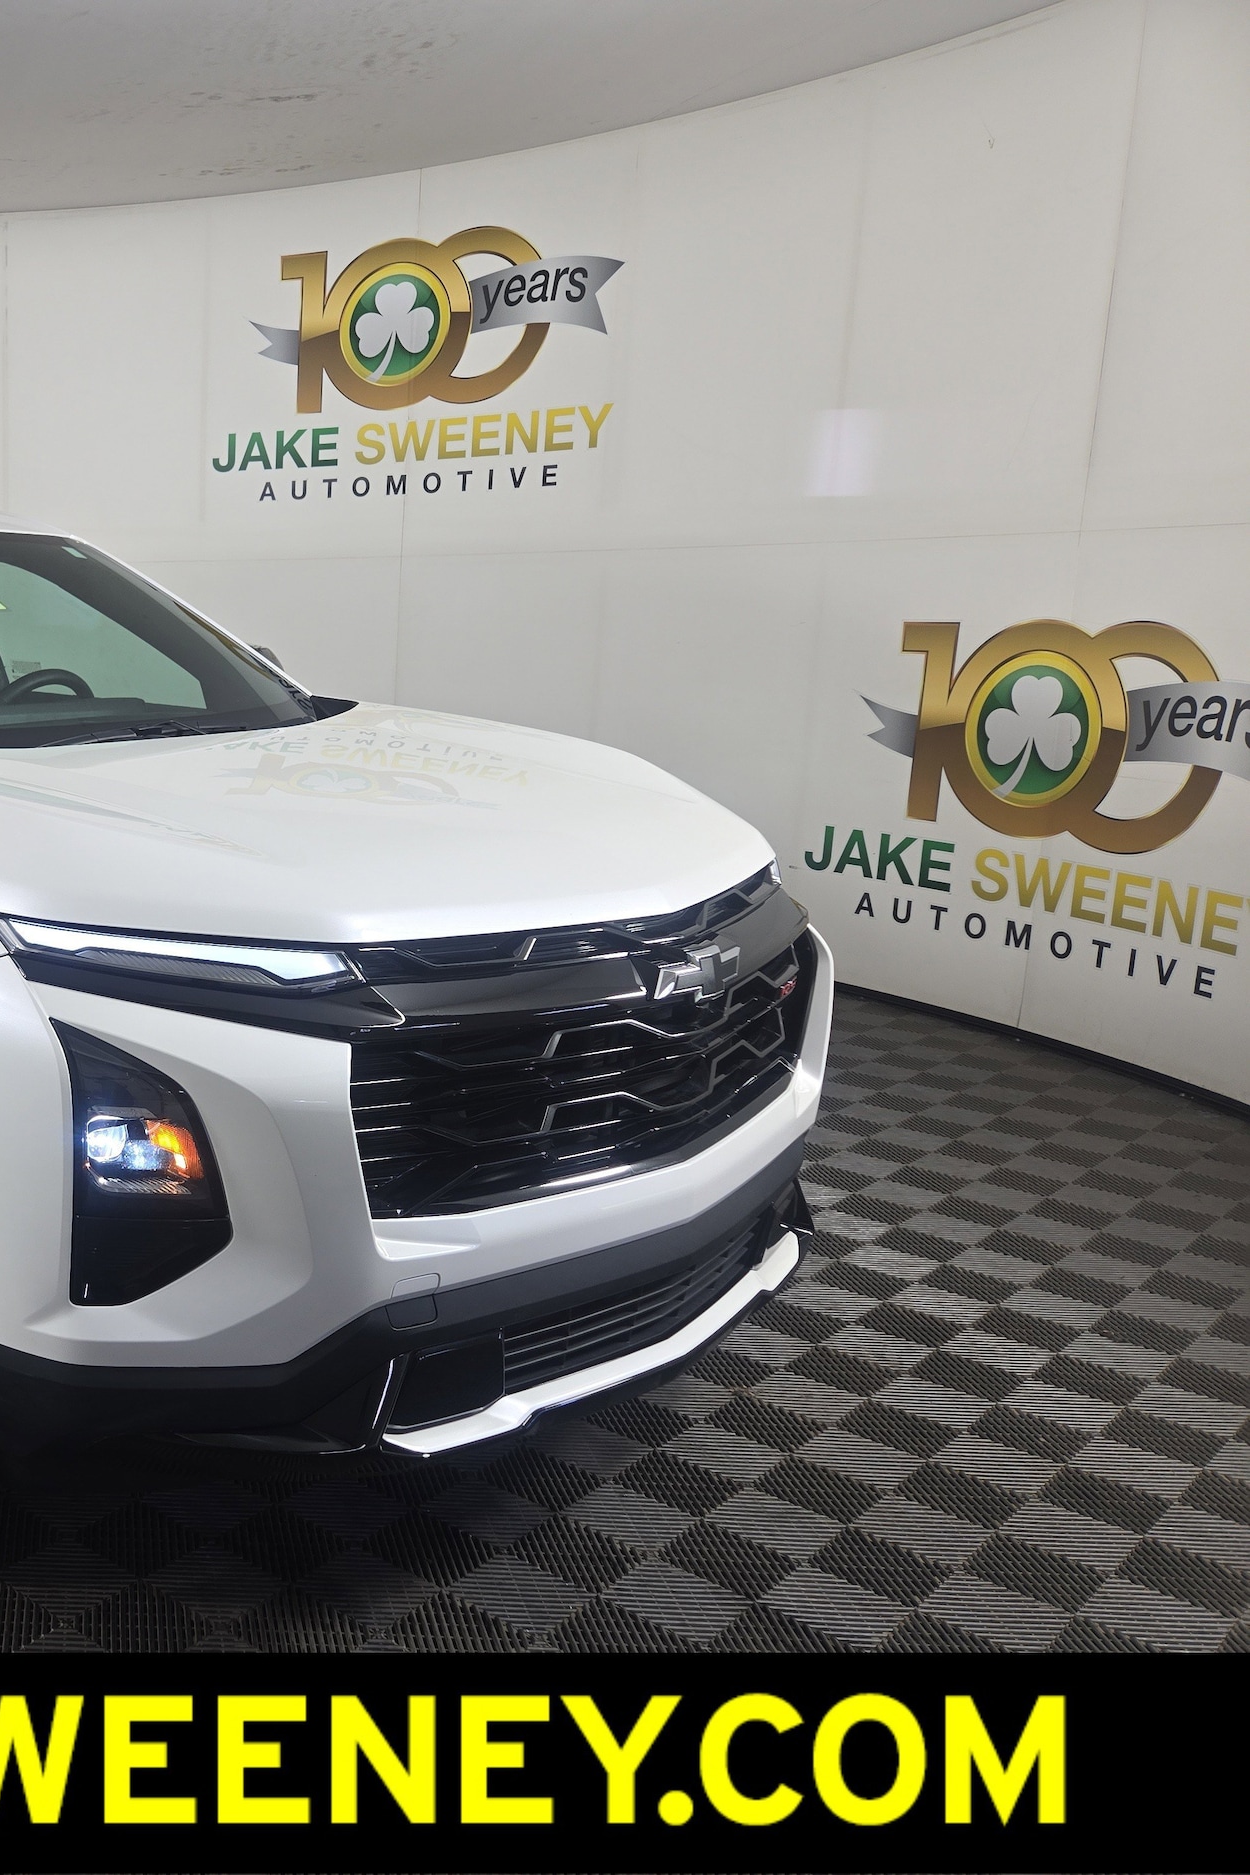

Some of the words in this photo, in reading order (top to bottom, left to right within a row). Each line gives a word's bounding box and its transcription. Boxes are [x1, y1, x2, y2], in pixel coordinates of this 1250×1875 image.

[281, 225, 550, 414] 100
[479, 262, 589, 325] years
[212, 427, 340, 473] JAKE
[354, 403, 614, 466] SWEENEY
[259, 464, 559, 502] AUTOMOTIVE
[901, 619, 1223, 854] 100
[1135, 695, 1250, 752] year
[804, 825, 956, 893] JAKE
[971, 848, 1250, 957] SWEENE
[854, 892, 1216, 999] AUTOMOTIVE
